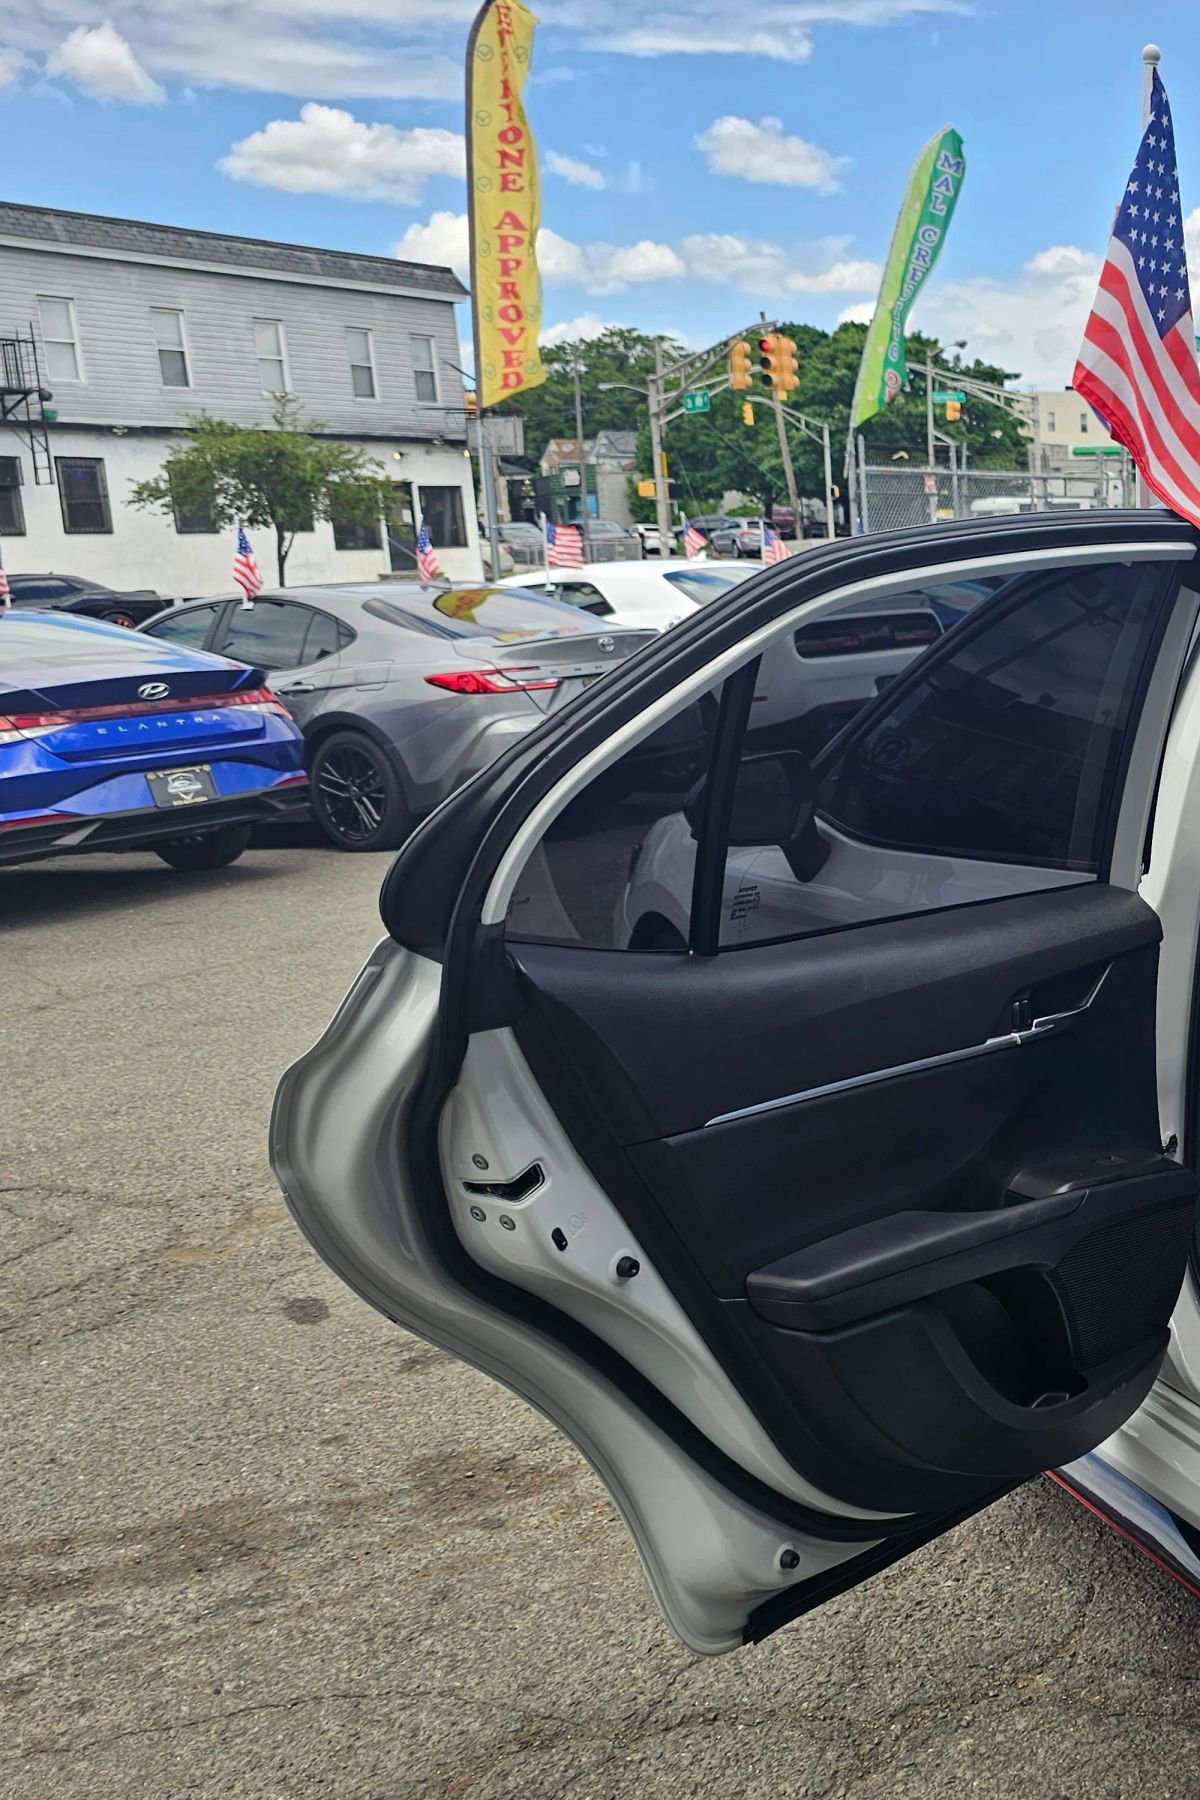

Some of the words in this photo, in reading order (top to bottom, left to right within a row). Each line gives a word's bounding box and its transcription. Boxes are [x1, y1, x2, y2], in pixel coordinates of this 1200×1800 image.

[931, 151, 964, 215] MAL
[493, 210, 529, 391] APPROVED
[97, 714, 221, 735] ELANTRA
